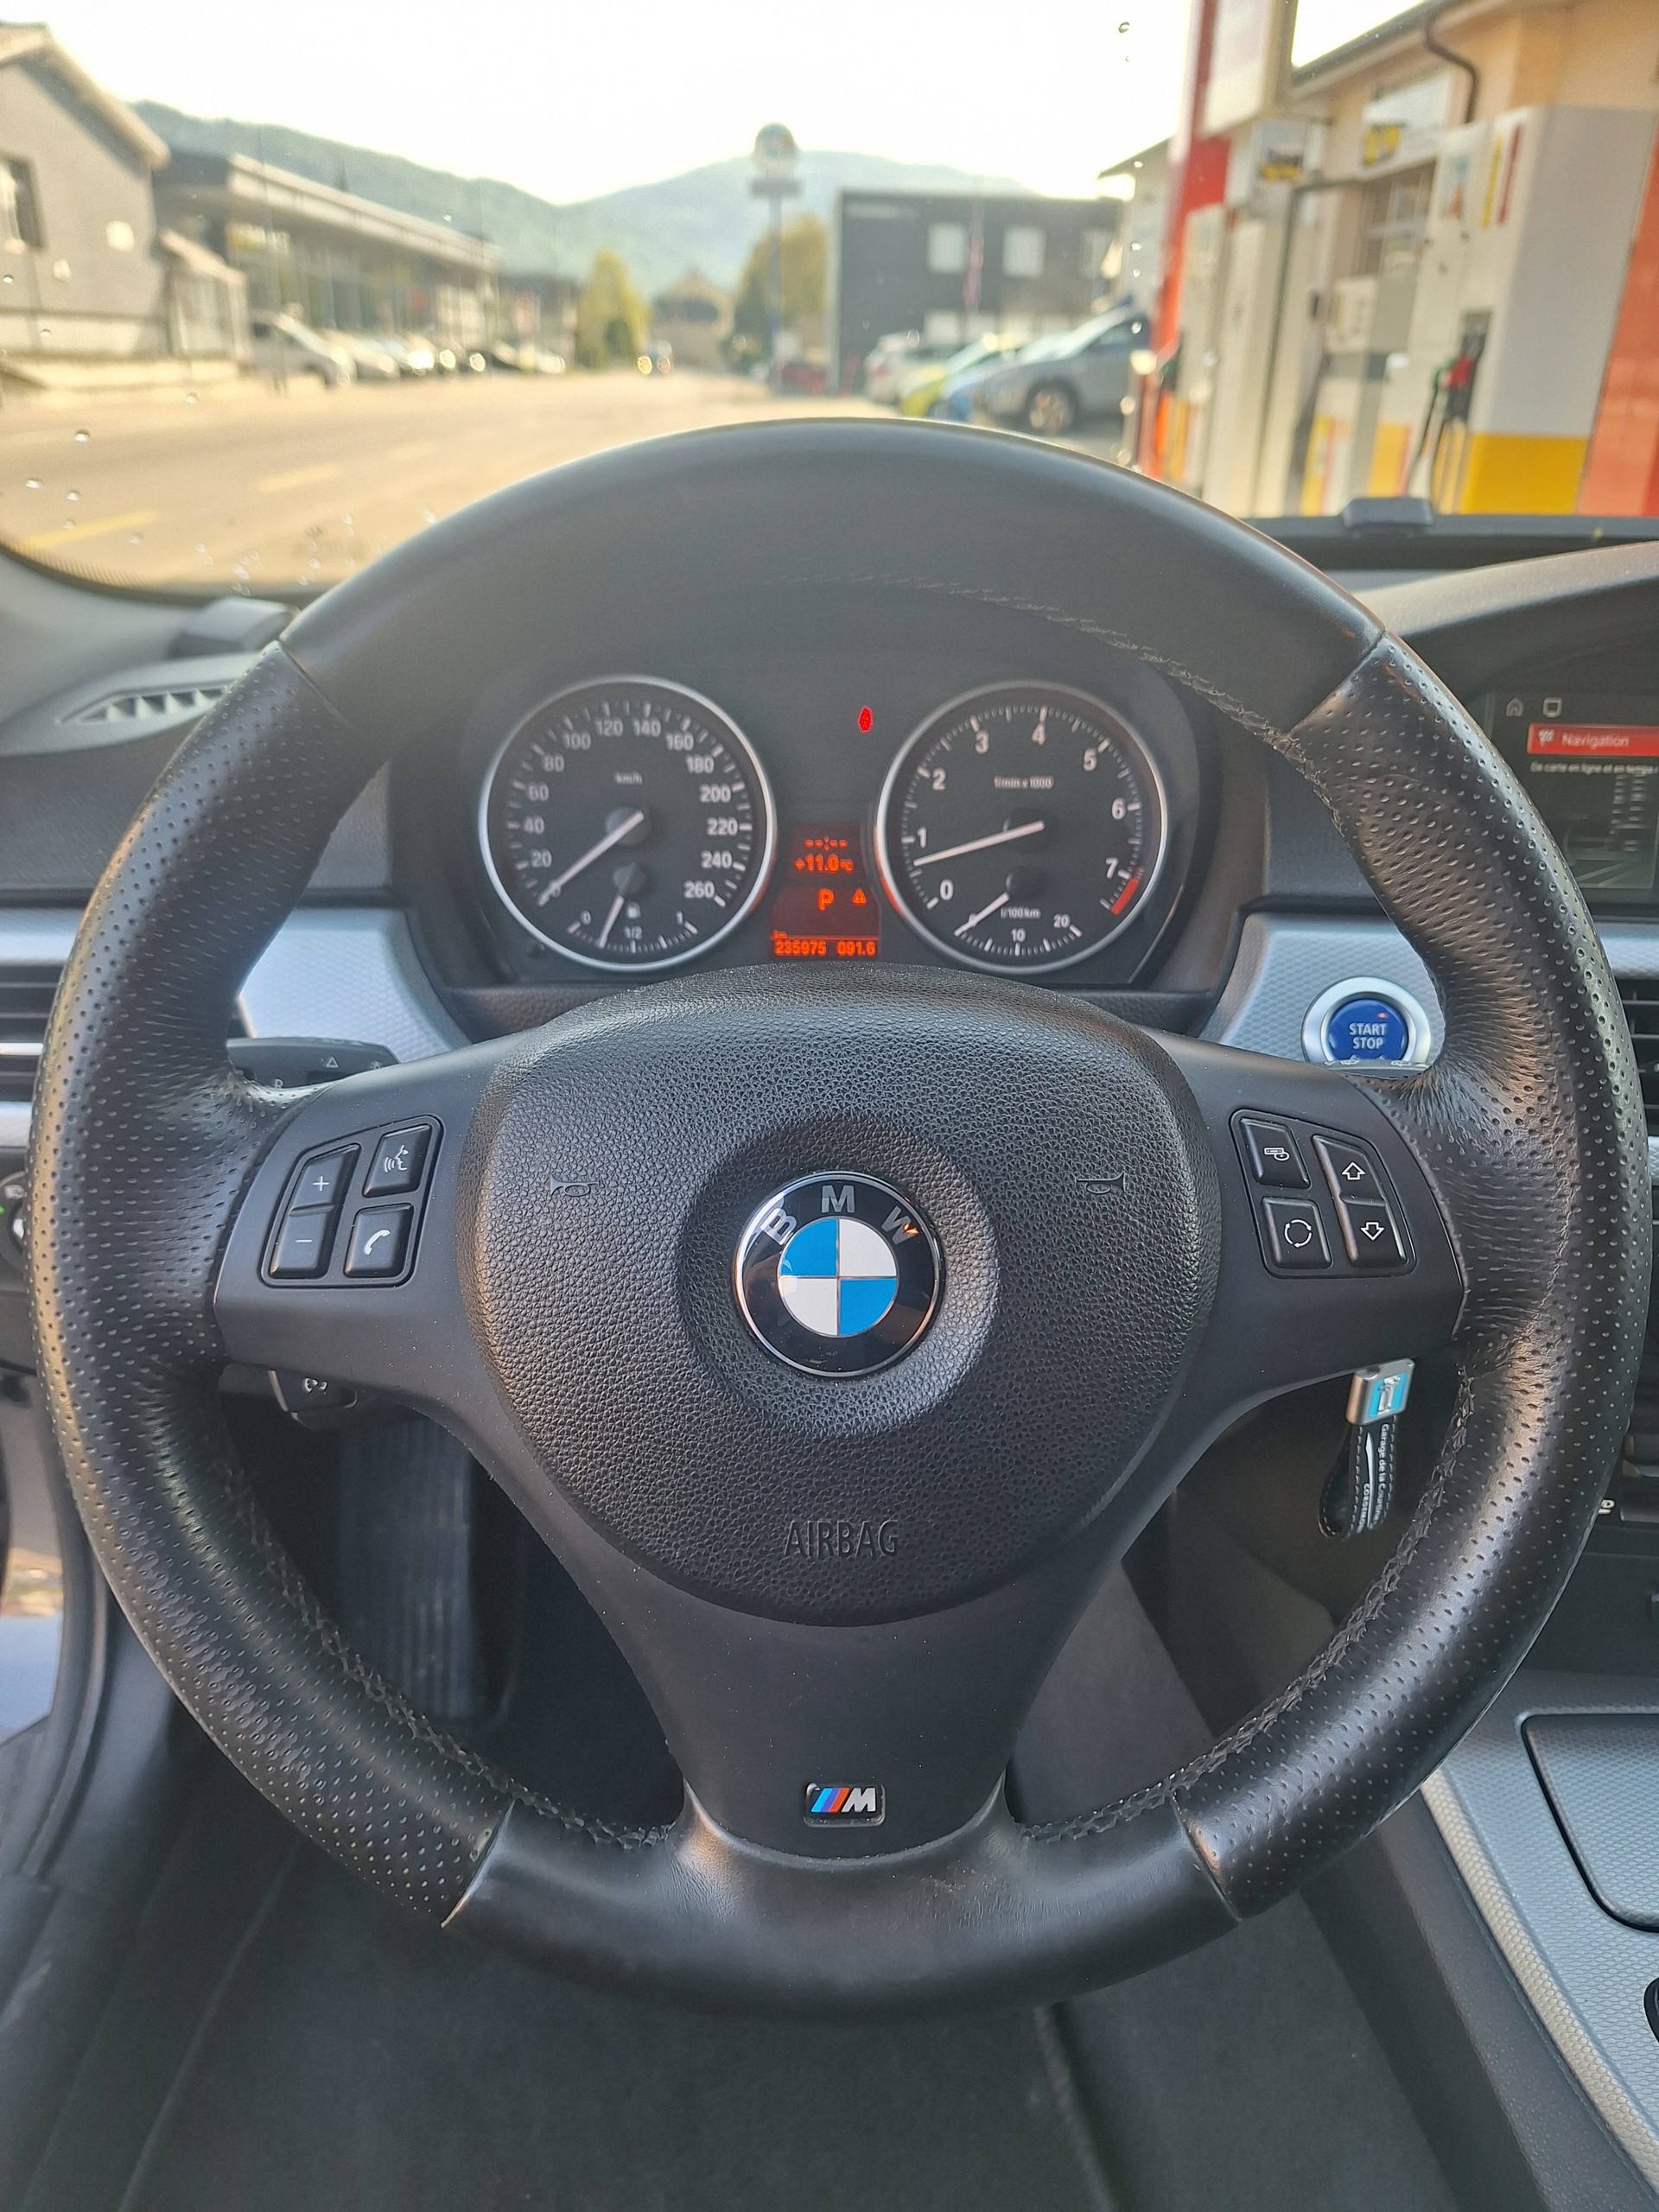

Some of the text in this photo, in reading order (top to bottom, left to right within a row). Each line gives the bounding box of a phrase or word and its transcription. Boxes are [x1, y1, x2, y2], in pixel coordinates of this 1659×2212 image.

[596, 719, 623, 735] 120
[633, 720, 661, 735] 140
[1032, 724, 1046, 745] 4
[563, 733, 591, 749] 100
[666, 734, 694, 750] 160
[976, 733, 989, 753] 3
[1561, 733, 1630, 749] Navigation
[543, 755, 564, 772] 80
[687, 756, 715, 773] 180
[1084, 749, 1097, 770] 5
[614, 772, 642, 785] km/h
[932, 769, 946, 790] 2
[1030, 776, 1054, 789] 1000
[527, 784, 549, 800] 60
[700, 785, 731, 802] 200
[1112, 798, 1125, 819] 6
[524, 818, 544, 834] 40
[707, 818, 738, 835] 220
[918, 827, 927, 848] 1
[531, 850, 552, 868] 20
[701, 851, 732, 868] 240
[1106, 857, 1119, 878] 7
[683, 880, 715, 899] 260
[940, 880, 954, 899] 0
[818, 888, 835, 912] P
[580, 911, 591, 924] 0
[676, 911, 683, 923] 1
[1053, 914, 1070, 928] 20
[625, 926, 642, 938] 1/2
[1011, 929, 1026, 942] 10
[774, 940, 876, 956] 235975 091.6
[1349, 1022, 1388, 1036] START
[1352, 1037, 1383, 1050] STOP
[760, 1185, 918, 1246] BMW
[1377, 1423, 1389, 1459] Garage
[785, 1519, 899, 1556] AIRBAG
